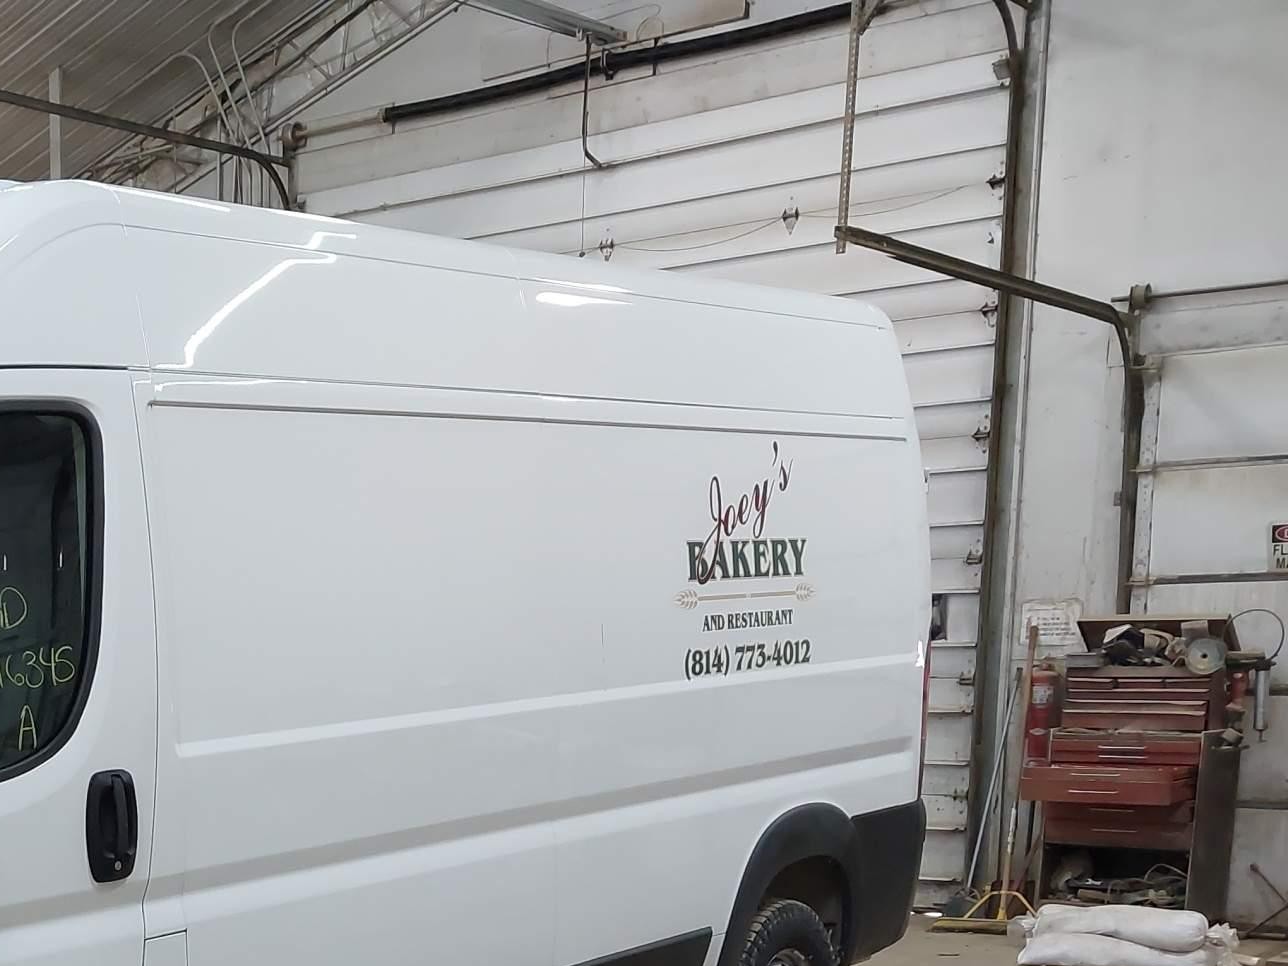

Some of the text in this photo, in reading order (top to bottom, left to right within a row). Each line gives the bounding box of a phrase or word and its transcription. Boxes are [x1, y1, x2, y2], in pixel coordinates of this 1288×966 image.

[696, 441, 793, 585] Joey's
[686, 538, 808, 582] BAKERY
[702, 609, 794, 632] AND RESTAURANT
[684, 639, 811, 680] (814) 773-4012
[18, 705, 38, 751] A
